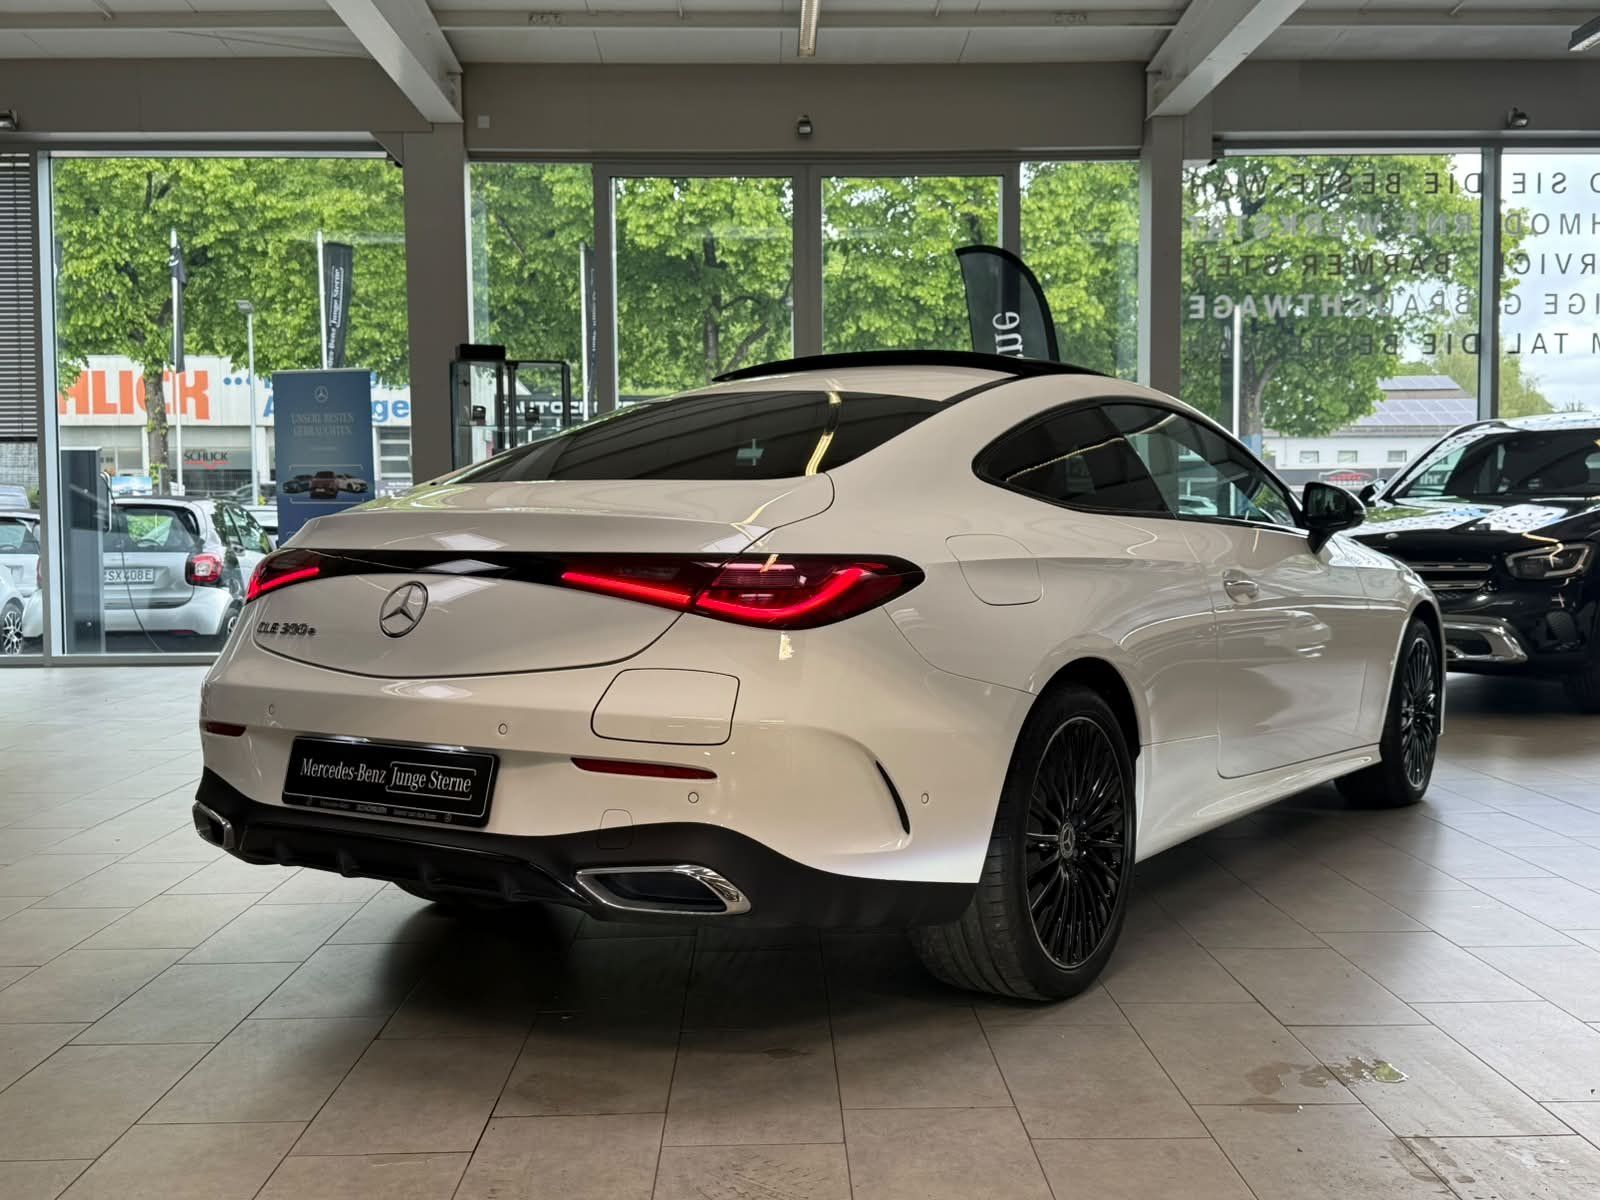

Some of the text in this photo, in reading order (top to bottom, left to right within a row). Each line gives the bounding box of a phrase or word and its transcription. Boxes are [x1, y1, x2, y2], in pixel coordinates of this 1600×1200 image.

[301, 757, 472, 794] Mercedes-Benz Junge Sterne
